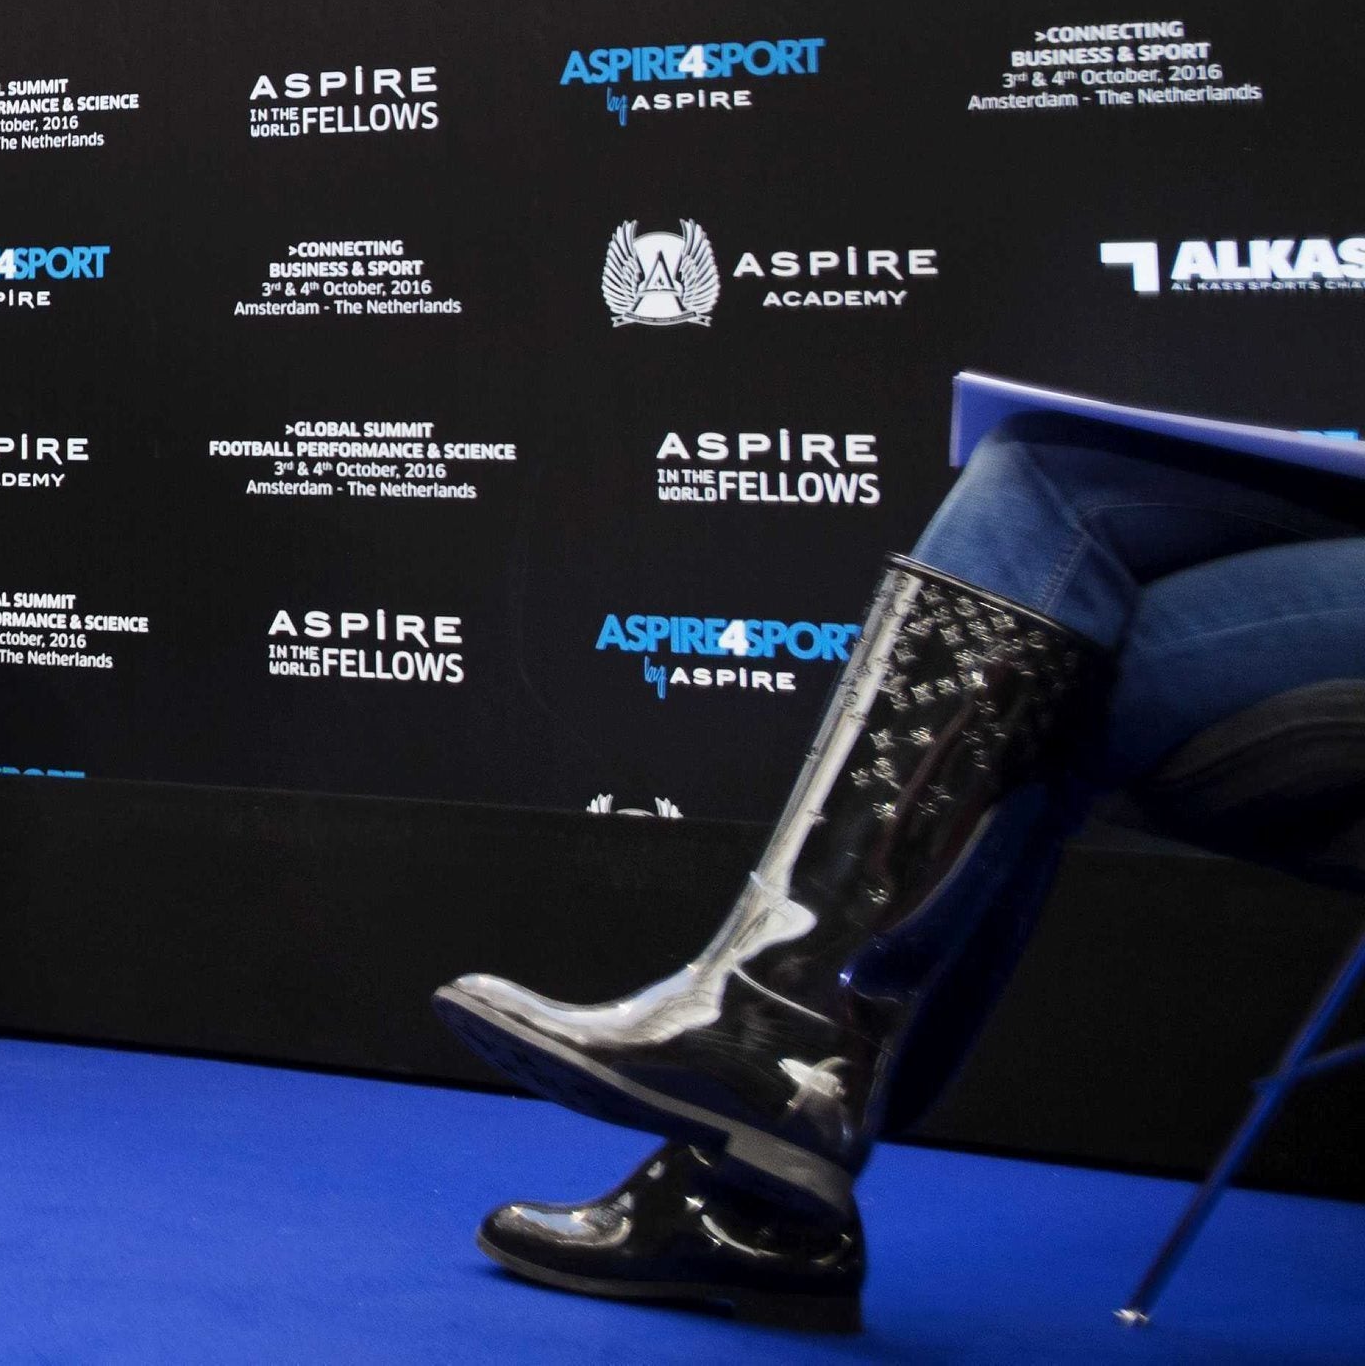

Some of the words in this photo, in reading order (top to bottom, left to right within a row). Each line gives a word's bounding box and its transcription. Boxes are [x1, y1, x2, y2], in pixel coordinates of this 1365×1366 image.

[559, 37, 825, 86] ASPIRE4SPORT
[7, 78, 69, 97] SUMMIT
[249, 65, 438, 101] ASPIRE
[62, 97, 75, 112] &
[77, 93, 140, 112] SCIENCE
[607, 87, 630, 126] by
[631, 89, 752, 111] ASPIRE
[42, 114, 79, 131] 2016
[250, 108, 268, 123] IN
[270, 106, 299, 121] THE
[302, 101, 439, 134] FELLOWS
[250, 122, 301, 138] WORLD
[21, 131, 105, 150] Netherlands
[288, 239, 404, 258] >CONNECTING
[269, 261, 349, 278] BUSINESS
[351, 260, 365, 277] &
[367, 259, 424, 277] SPORT
[732, 245, 939, 281] ASPIRE
[261, 281, 282, 297] 3rd
[284, 281, 297, 297] &
[299, 281, 320, 296] 4th
[322, 280, 387, 297] October,
[390, 279, 433, 295] 2016
[233, 299, 320, 316] Amsterdam
[333, 299, 363, 315] The
[366, 297, 462, 315] Netherlands
[762, 290, 908, 307] ACADEMY
[656, 428, 878, 468] ASPIRE
[657, 468, 680, 484] IN
[681, 468, 716, 485] THE
[658, 485, 718, 502] WORLD
[718, 470, 881, 505] FELLOWS
